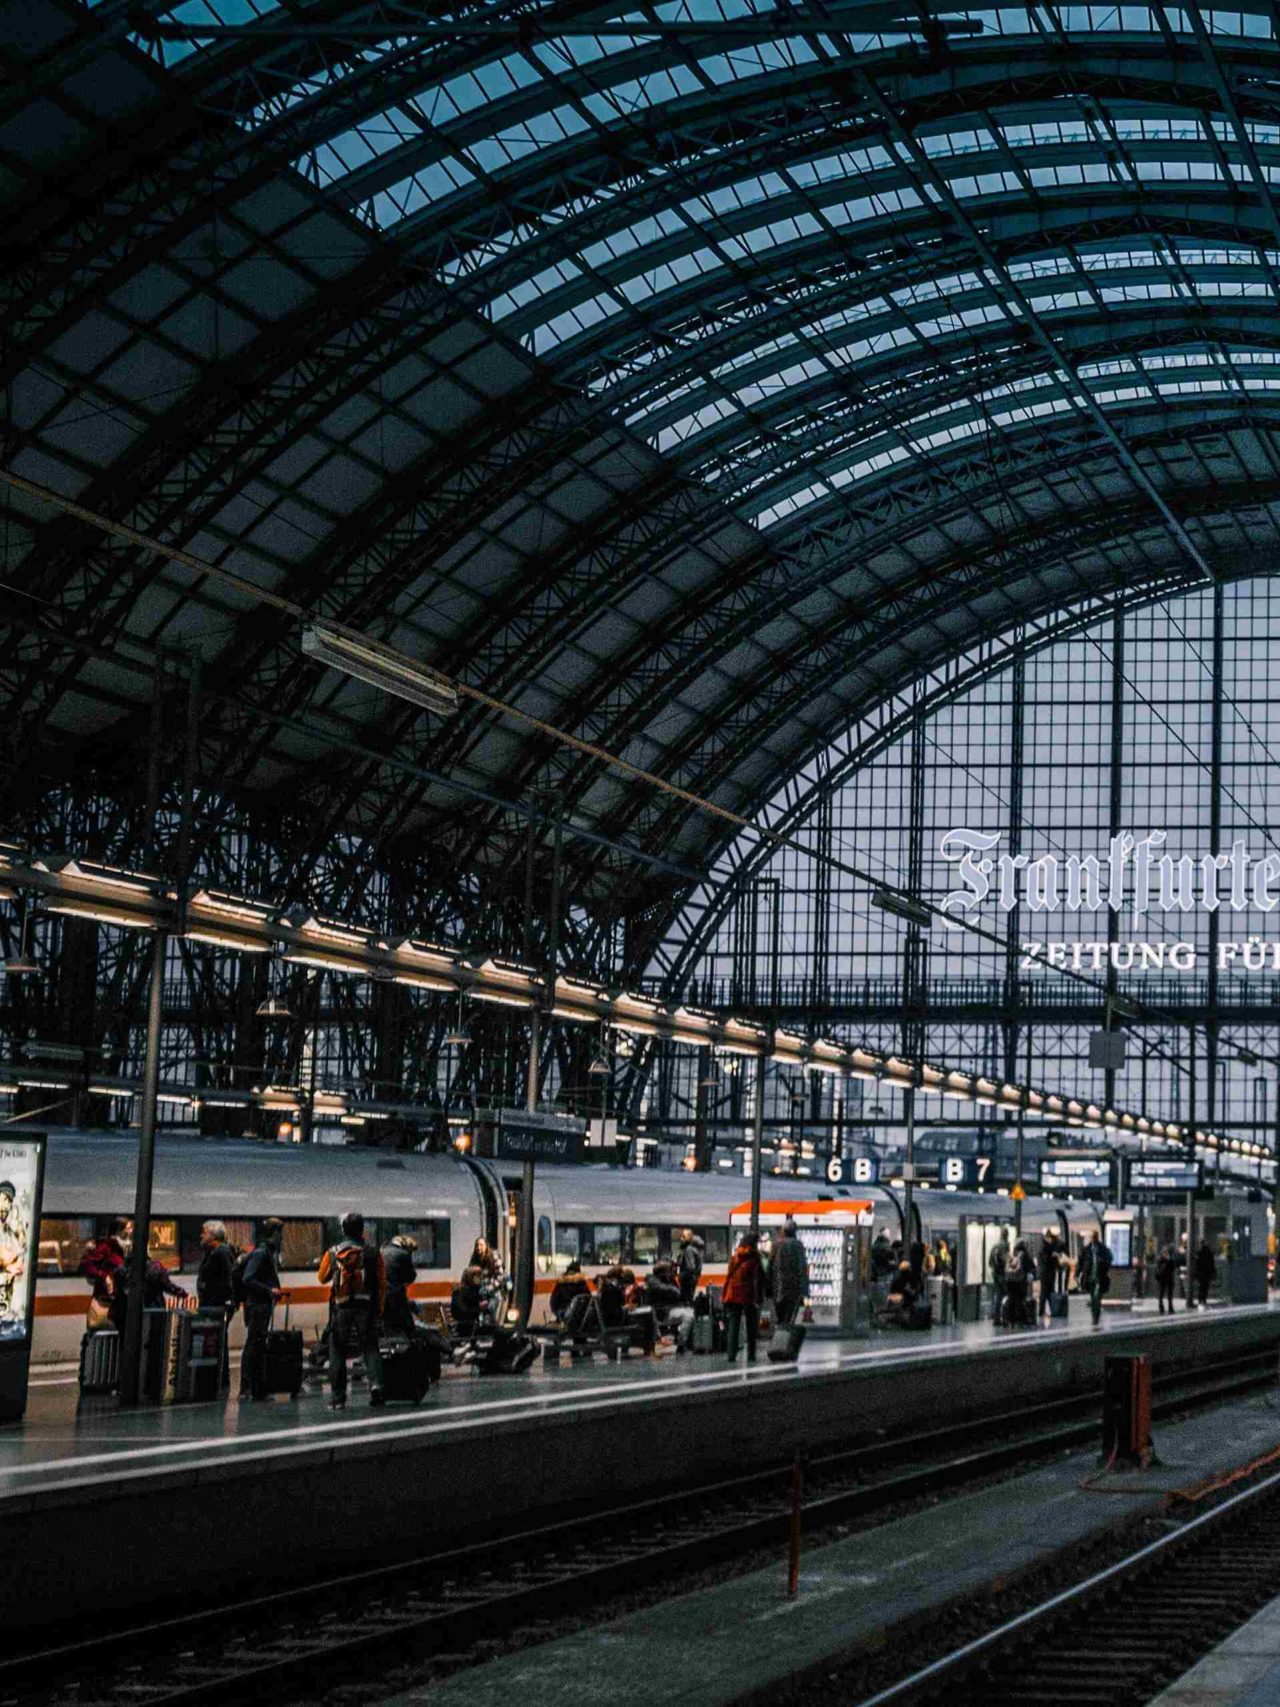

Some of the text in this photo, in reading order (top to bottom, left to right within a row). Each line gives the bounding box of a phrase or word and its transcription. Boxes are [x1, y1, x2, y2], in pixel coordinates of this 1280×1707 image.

[1020, 942, 1197, 970] ZEITUNG
[827, 1158, 871, 1182] 6 B
[946, 1158, 991, 1182] B 7
